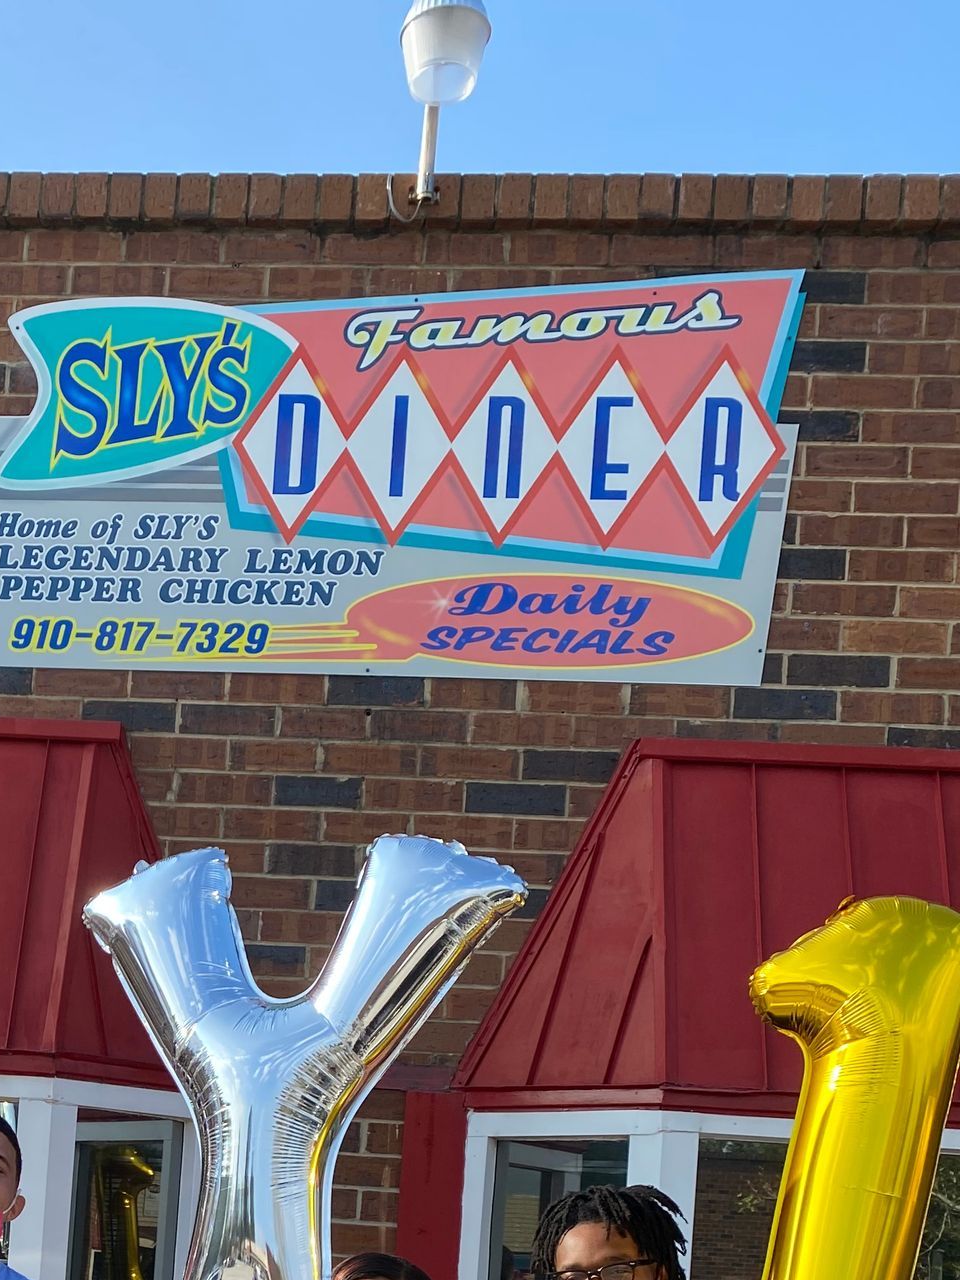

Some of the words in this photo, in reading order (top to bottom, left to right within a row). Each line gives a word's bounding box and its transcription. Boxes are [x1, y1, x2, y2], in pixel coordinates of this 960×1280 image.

[345, 288, 743, 372] Famous
[272, 393, 744, 502] DINER
[91, 513, 124, 545] of
[134, 515, 219, 540] SLY'S
[244, 547, 384, 577] LEMON
[159, 579, 338, 606] CHICKEN
[447, 582, 652, 629] Daily
[10, 617, 271, 655] 910-817-7329
[420, 625, 676, 656] SPECIALS
